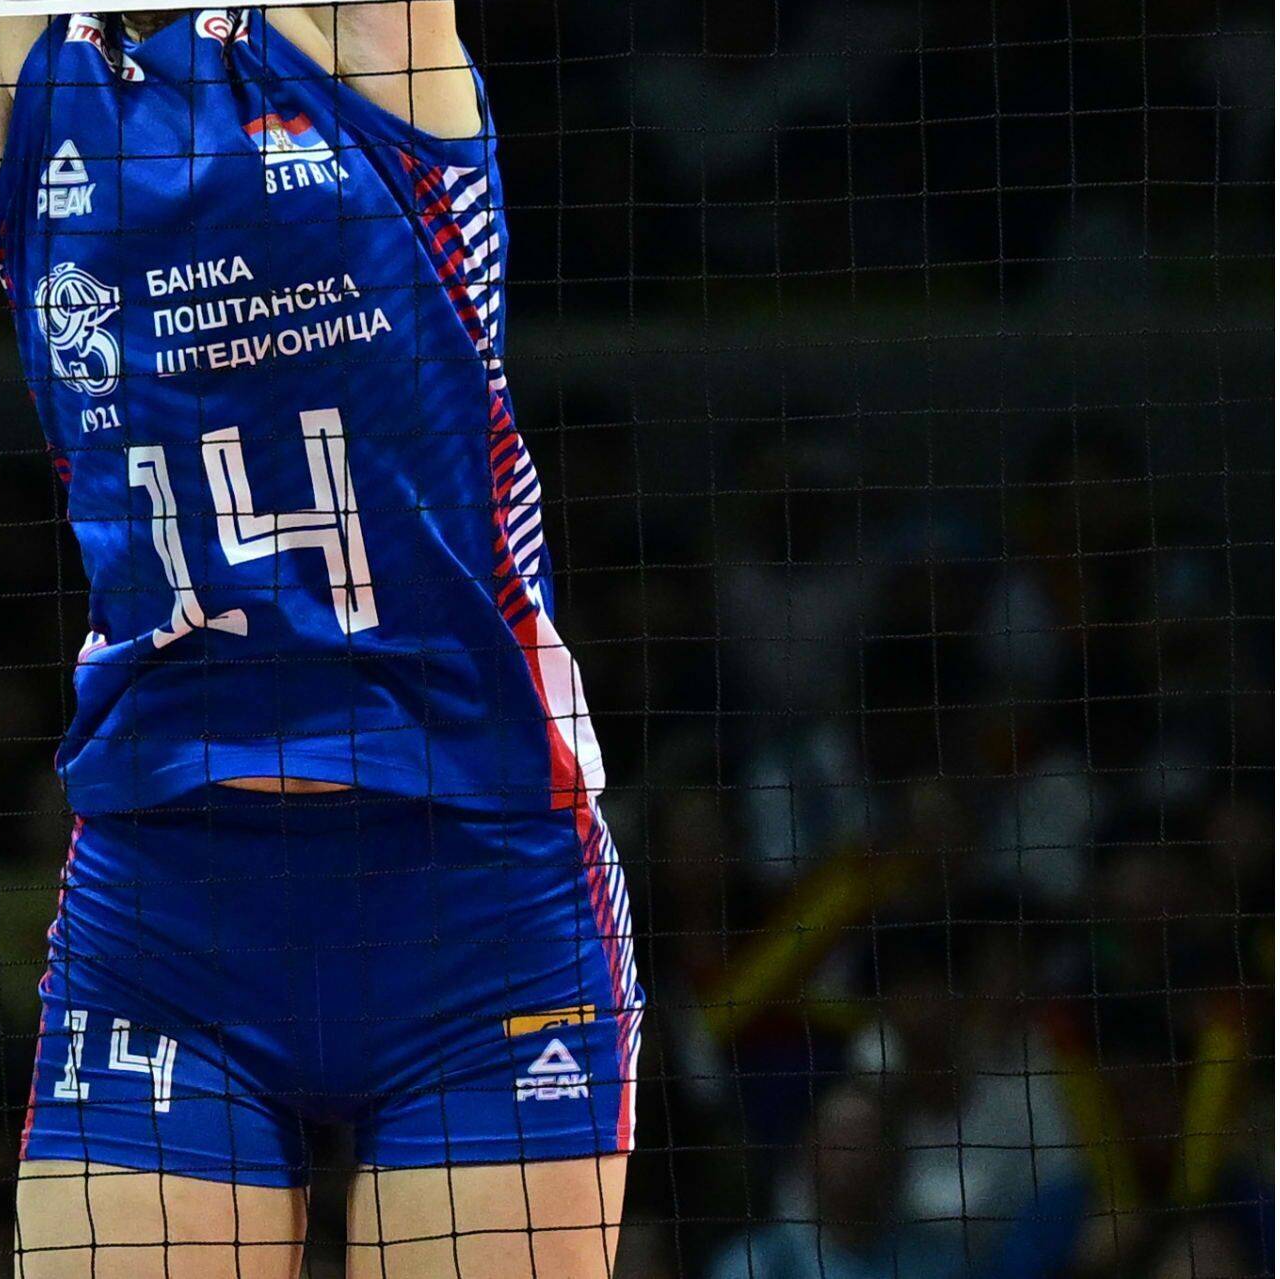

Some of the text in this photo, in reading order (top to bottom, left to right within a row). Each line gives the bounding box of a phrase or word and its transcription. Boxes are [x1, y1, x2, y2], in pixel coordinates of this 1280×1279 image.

[264, 160, 350, 194] SERBIA
[37, 183, 97, 220] PEAK
[146, 255, 254, 297] БАНКА
[153, 273, 361, 338] ПОШТАНСКА
[156, 307, 392, 378] ШТЕДИОНИЦА
[80, 403, 122, 433] 1921
[127, 407, 380, 650] 14
[53, 1009, 178, 1113] 14
[515, 1073, 593, 1101] PEAK
